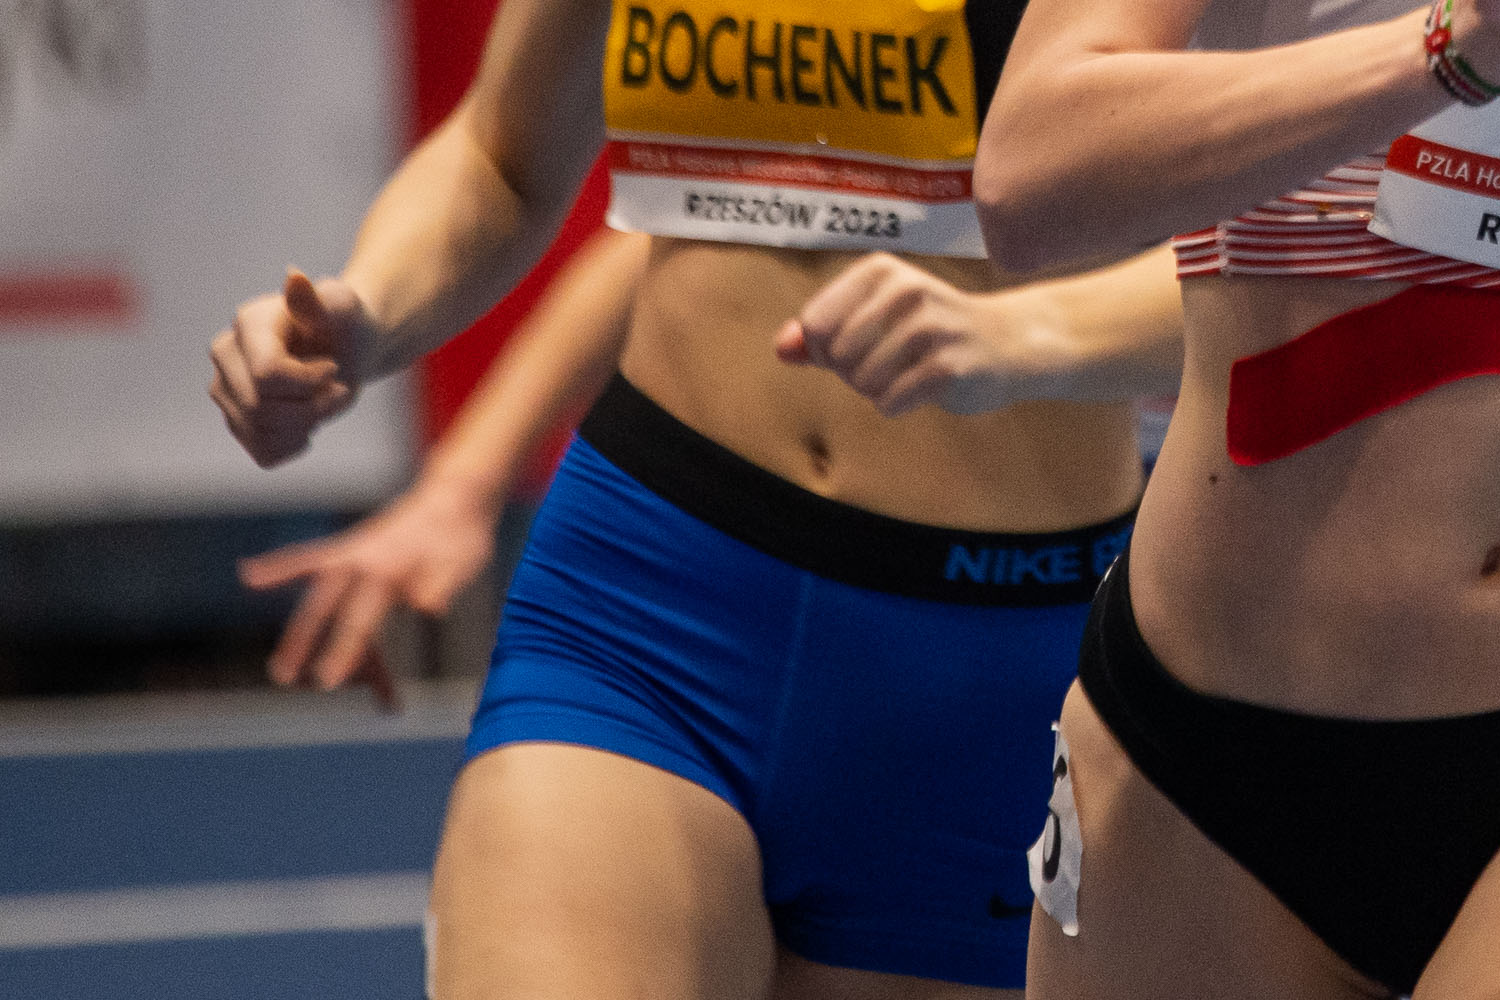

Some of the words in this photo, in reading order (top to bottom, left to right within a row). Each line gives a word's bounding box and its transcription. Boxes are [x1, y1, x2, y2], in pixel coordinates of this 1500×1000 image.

[621, 6, 958, 117] BOCHENEK
[1416, 151, 1470, 182] PZLA
[685, 192, 815, 229] RZESZÓW
[824, 206, 900, 239] 2023
[944, 543, 1082, 585] NIKE
